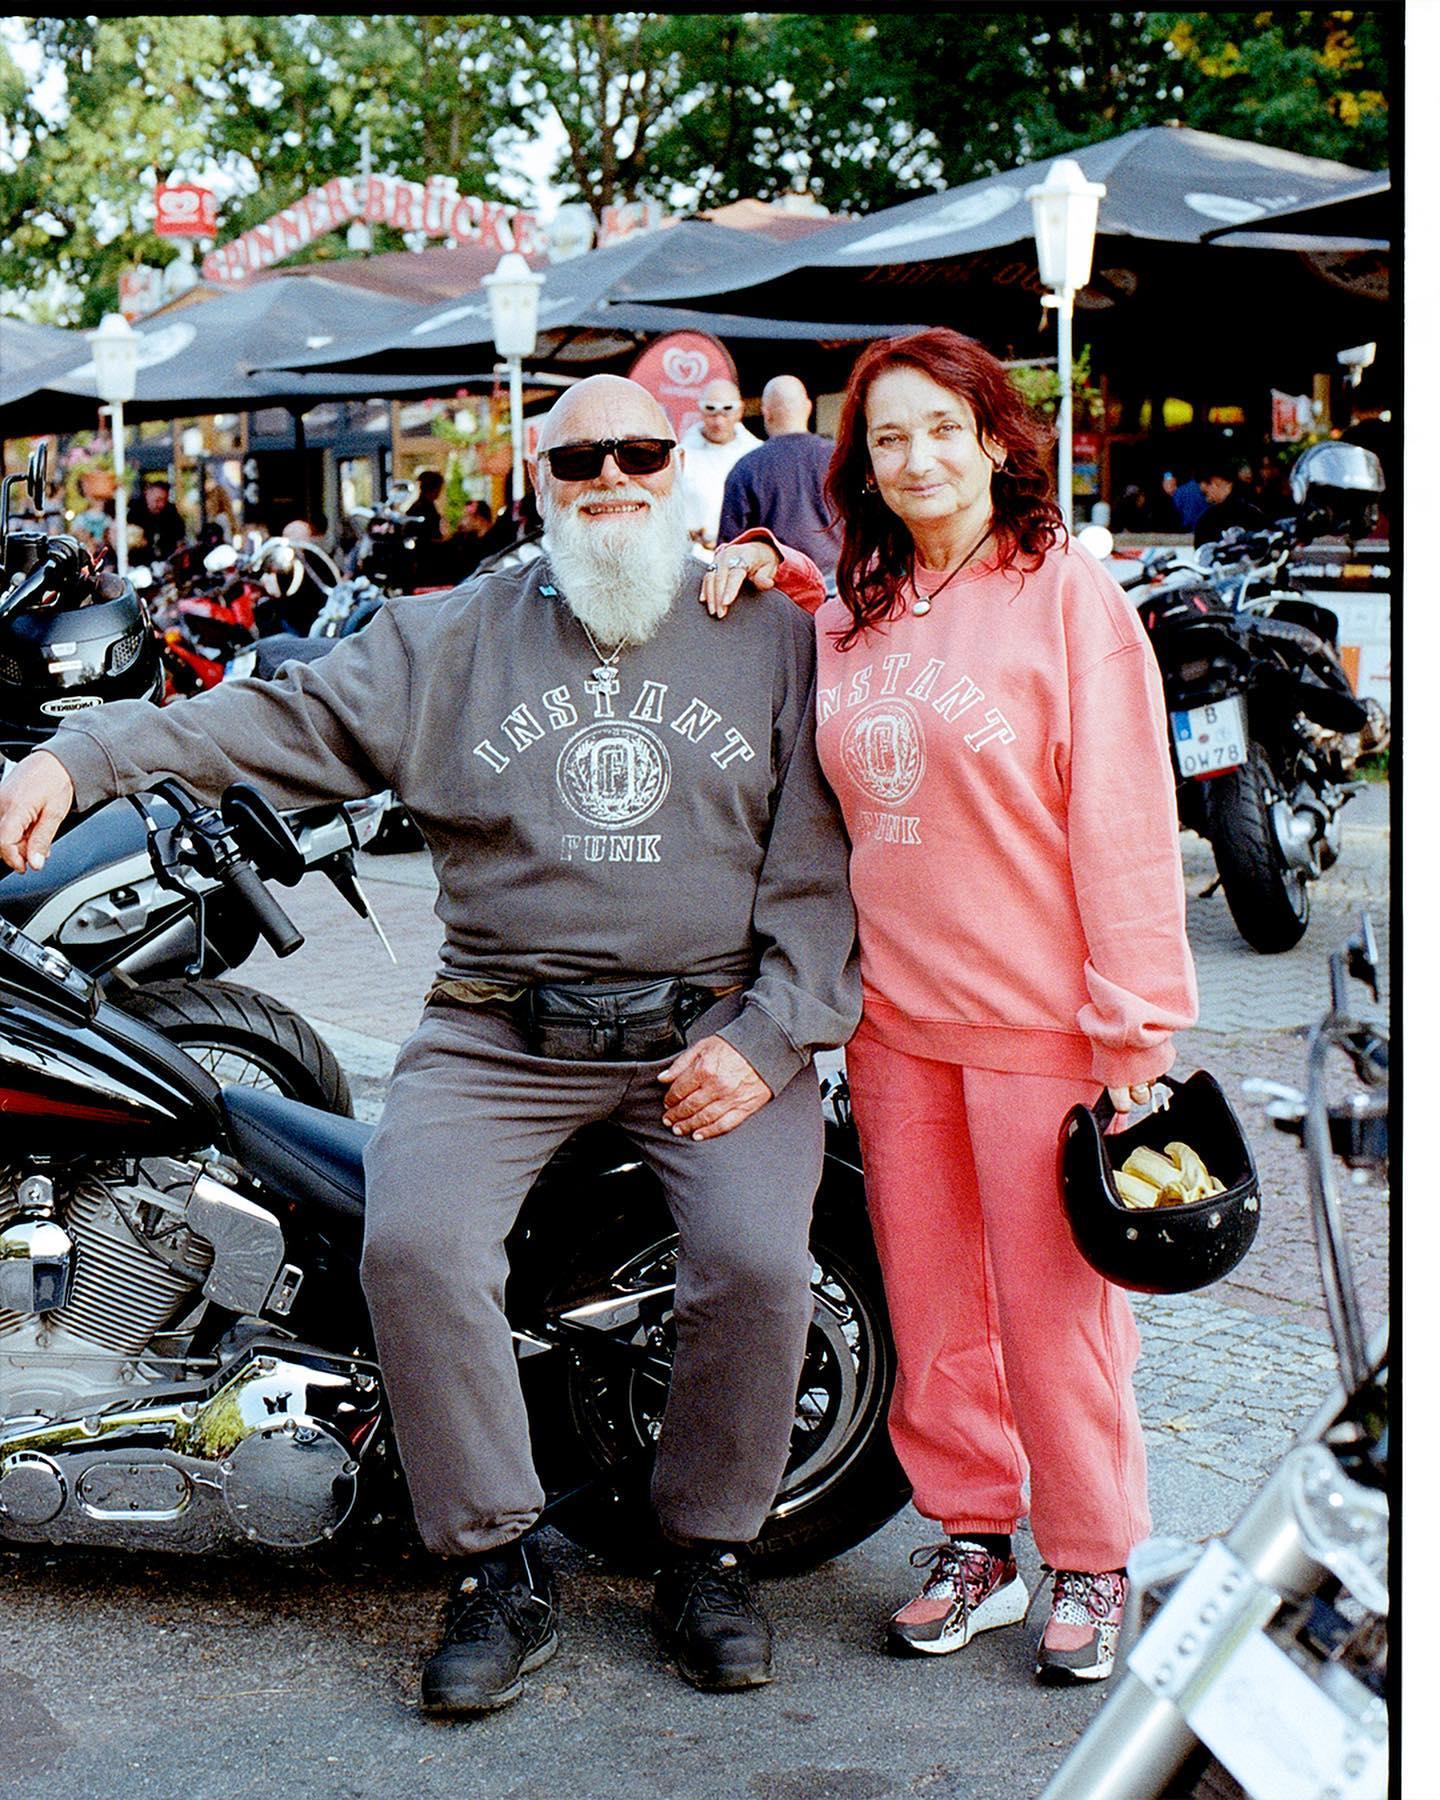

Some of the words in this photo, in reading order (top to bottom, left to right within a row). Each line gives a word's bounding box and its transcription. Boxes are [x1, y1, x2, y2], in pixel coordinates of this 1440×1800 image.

[473, 680, 756, 774] INSTANT
[1205, 706, 1218, 724] B
[560, 834, 662, 862] FUNK
